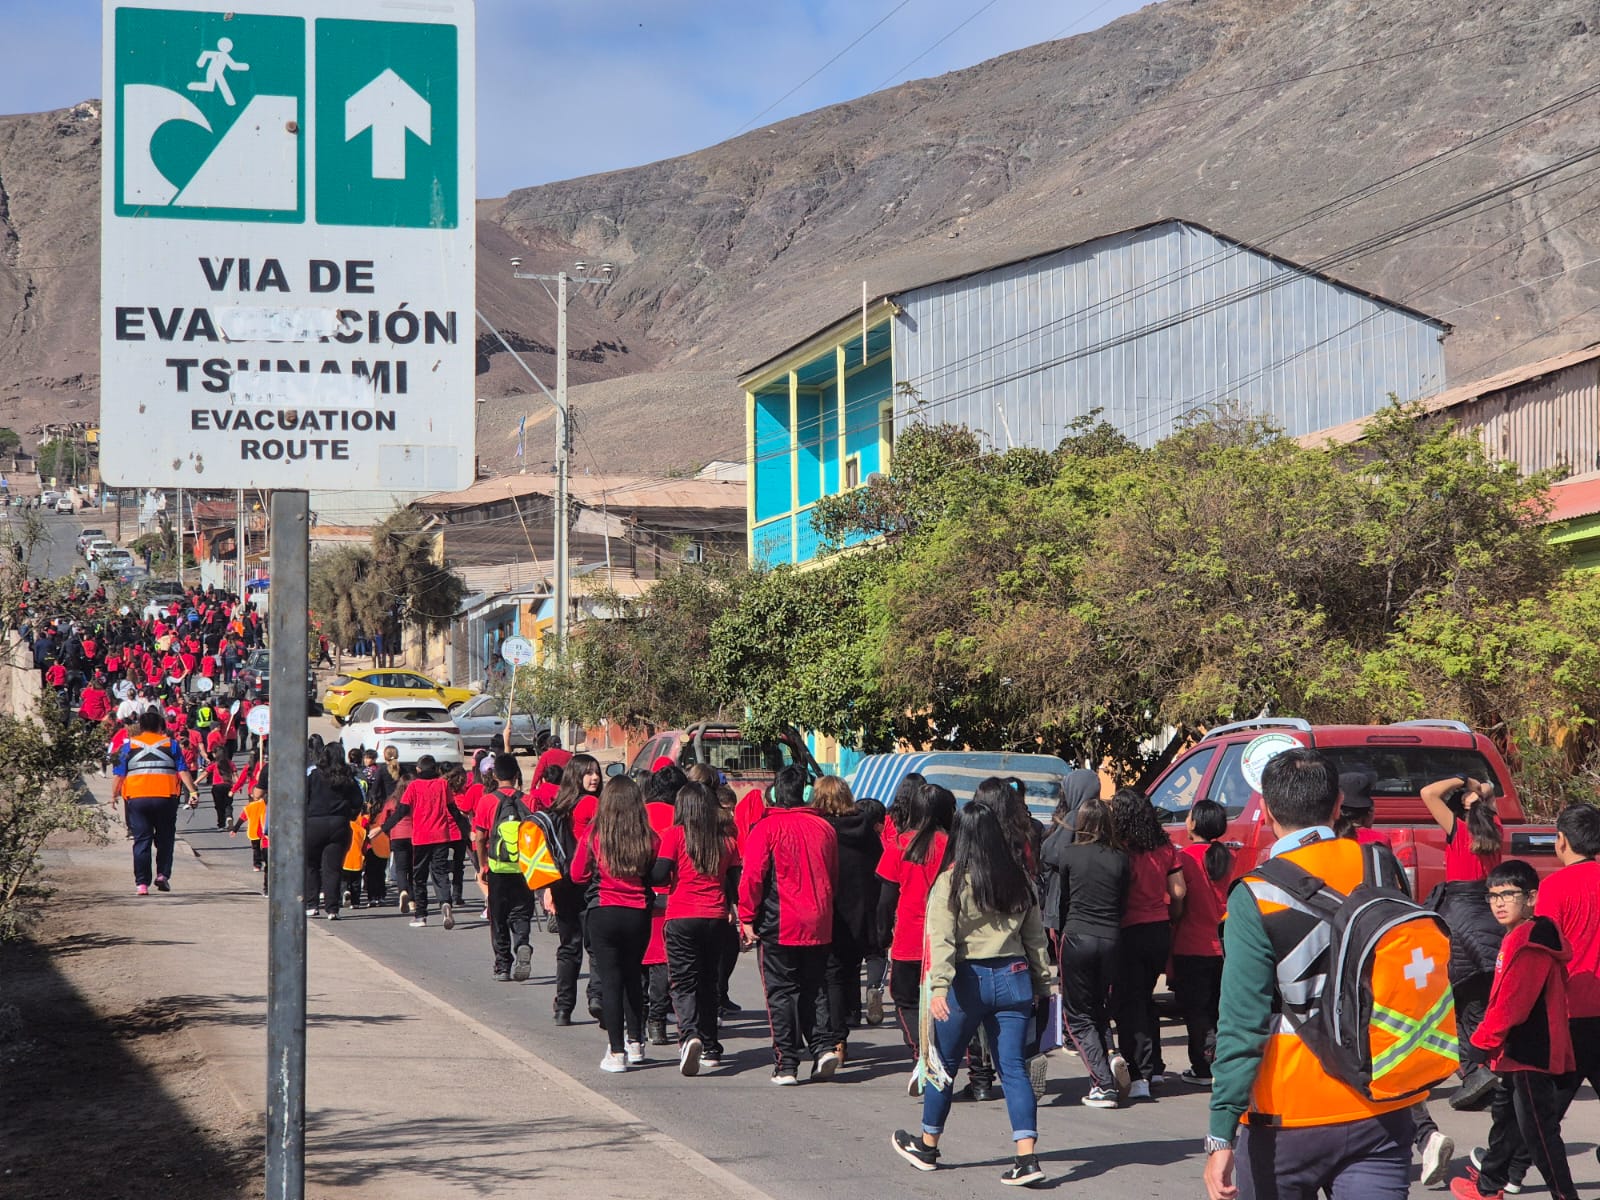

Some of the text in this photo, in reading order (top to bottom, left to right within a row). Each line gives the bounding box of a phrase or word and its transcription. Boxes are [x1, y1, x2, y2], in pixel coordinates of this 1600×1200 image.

[199, 257, 375, 294] VIA DE
[115, 303, 457, 344] EVACIÓN
[191, 409, 396, 431] EVACUATION
[241, 439, 349, 460] ROUTE
